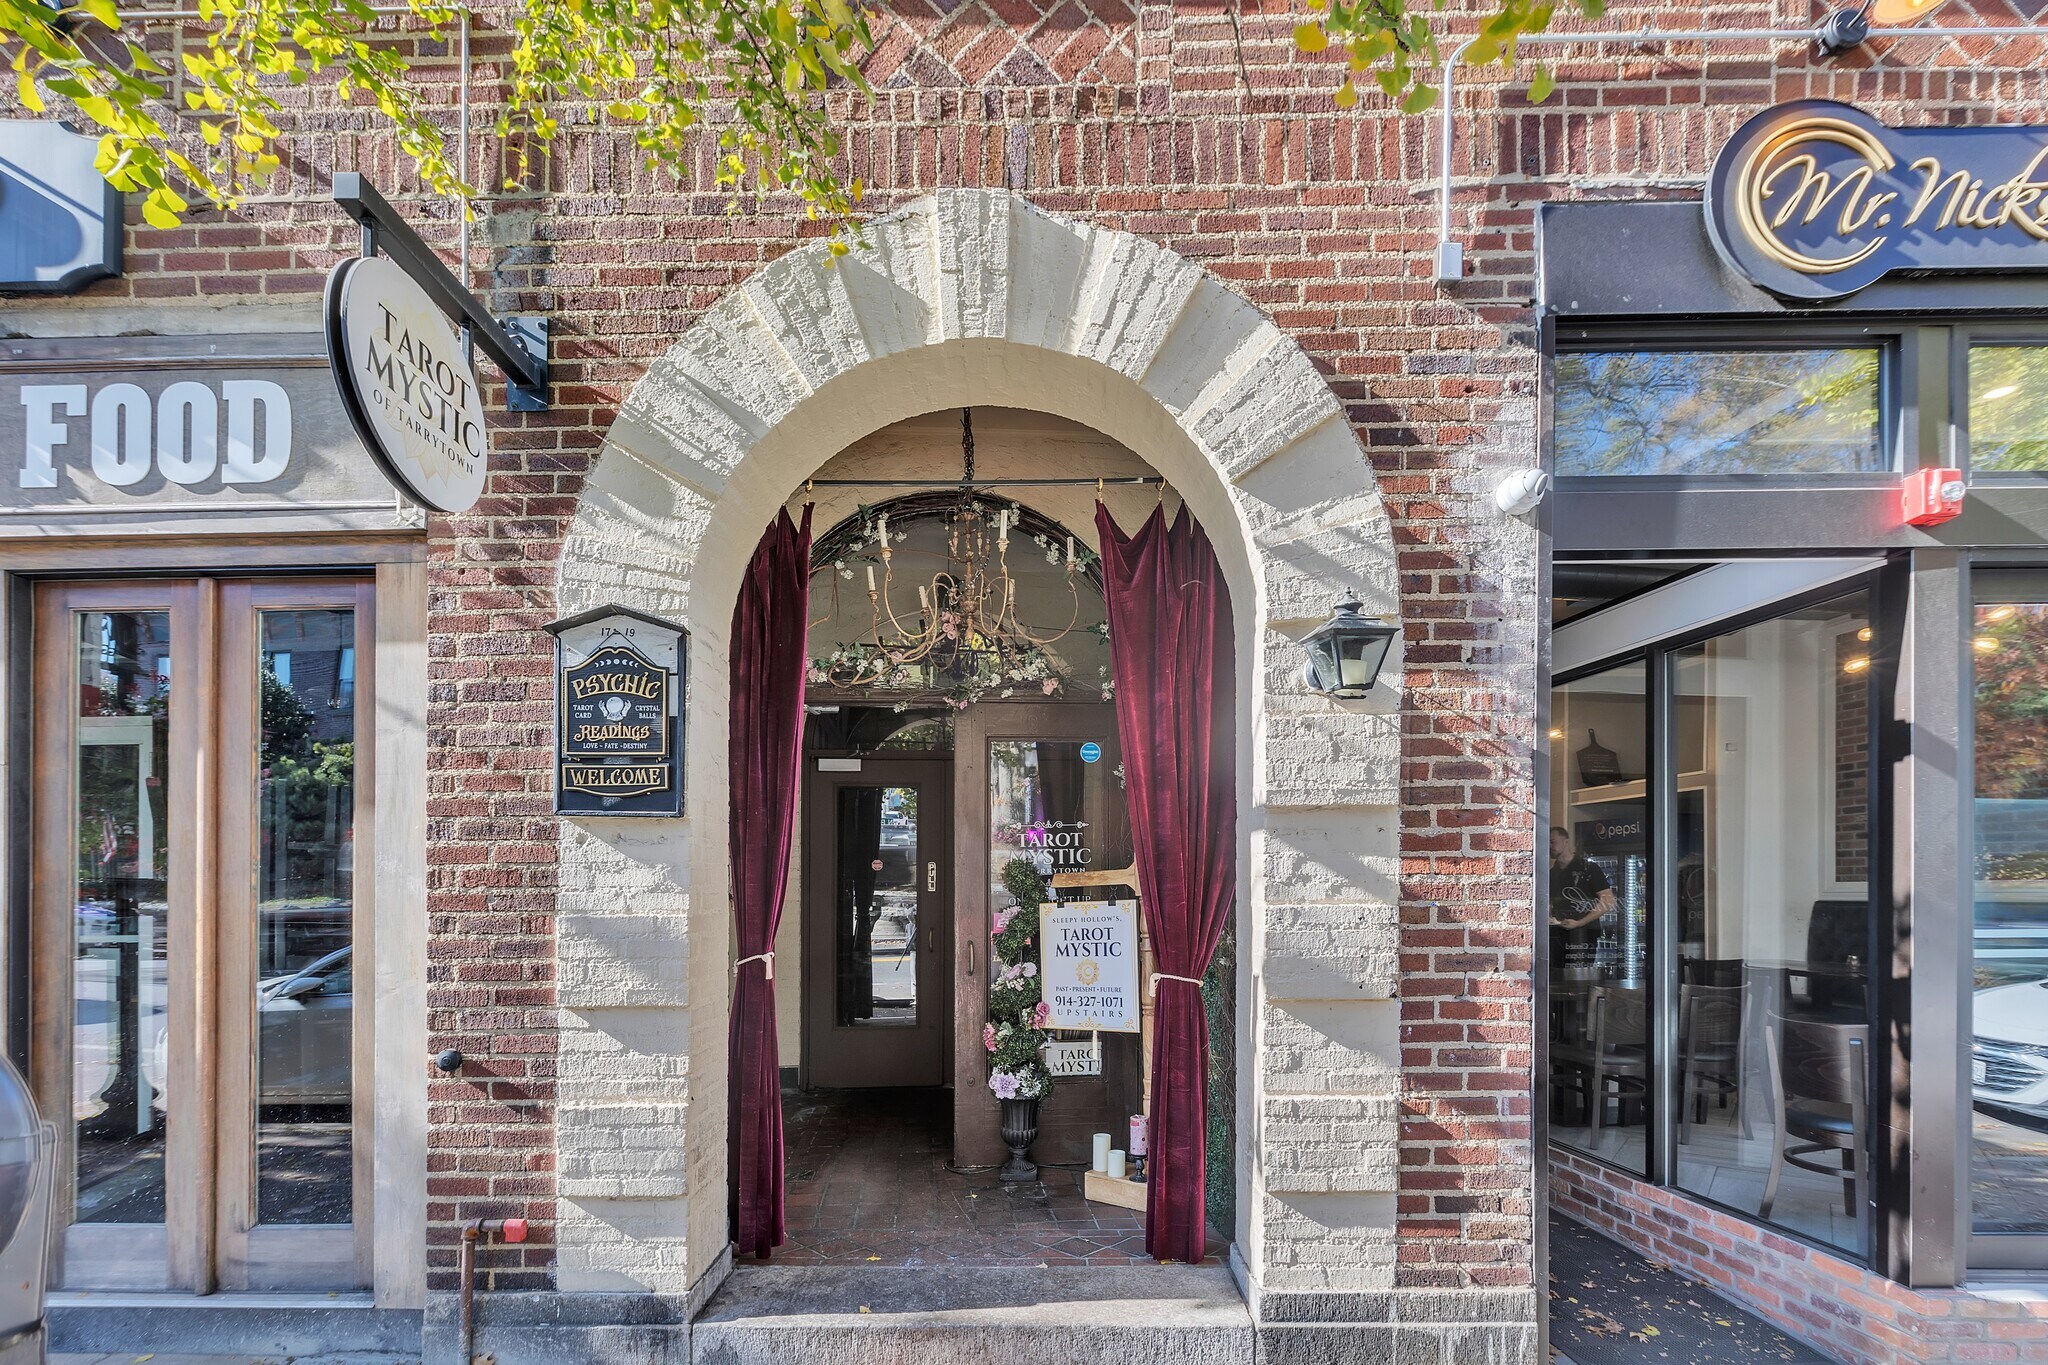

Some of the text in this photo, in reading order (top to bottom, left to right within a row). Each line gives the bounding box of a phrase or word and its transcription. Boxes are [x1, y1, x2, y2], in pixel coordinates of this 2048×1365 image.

[1761, 154, 1898, 235] Mr.
[378, 302, 471, 410] TAROT
[366, 335, 480, 458] MYSTIC
[19, 380, 292, 489] FOOD
[373, 389, 474, 475] OF TARRYTOWN
[601, 628, 635, 637] 17 19
[570, 768, 661, 786] WELCOME
[1608, 821, 1640, 838] pepsi
[1017, 832, 1083, 847] TAROT
[1010, 848, 1092, 865] MYSTIC
[1061, 927, 1114, 941] TAROT
[1056, 942, 1122, 957] MYSTIC
[1055, 995, 1123, 1007] 914-327-1071
[1057, 1008, 1123, 1017] UPSTAIRS
[1058, 1049, 1094, 1060] TARO
[1052, 1060, 1101, 1073] MYSTI
